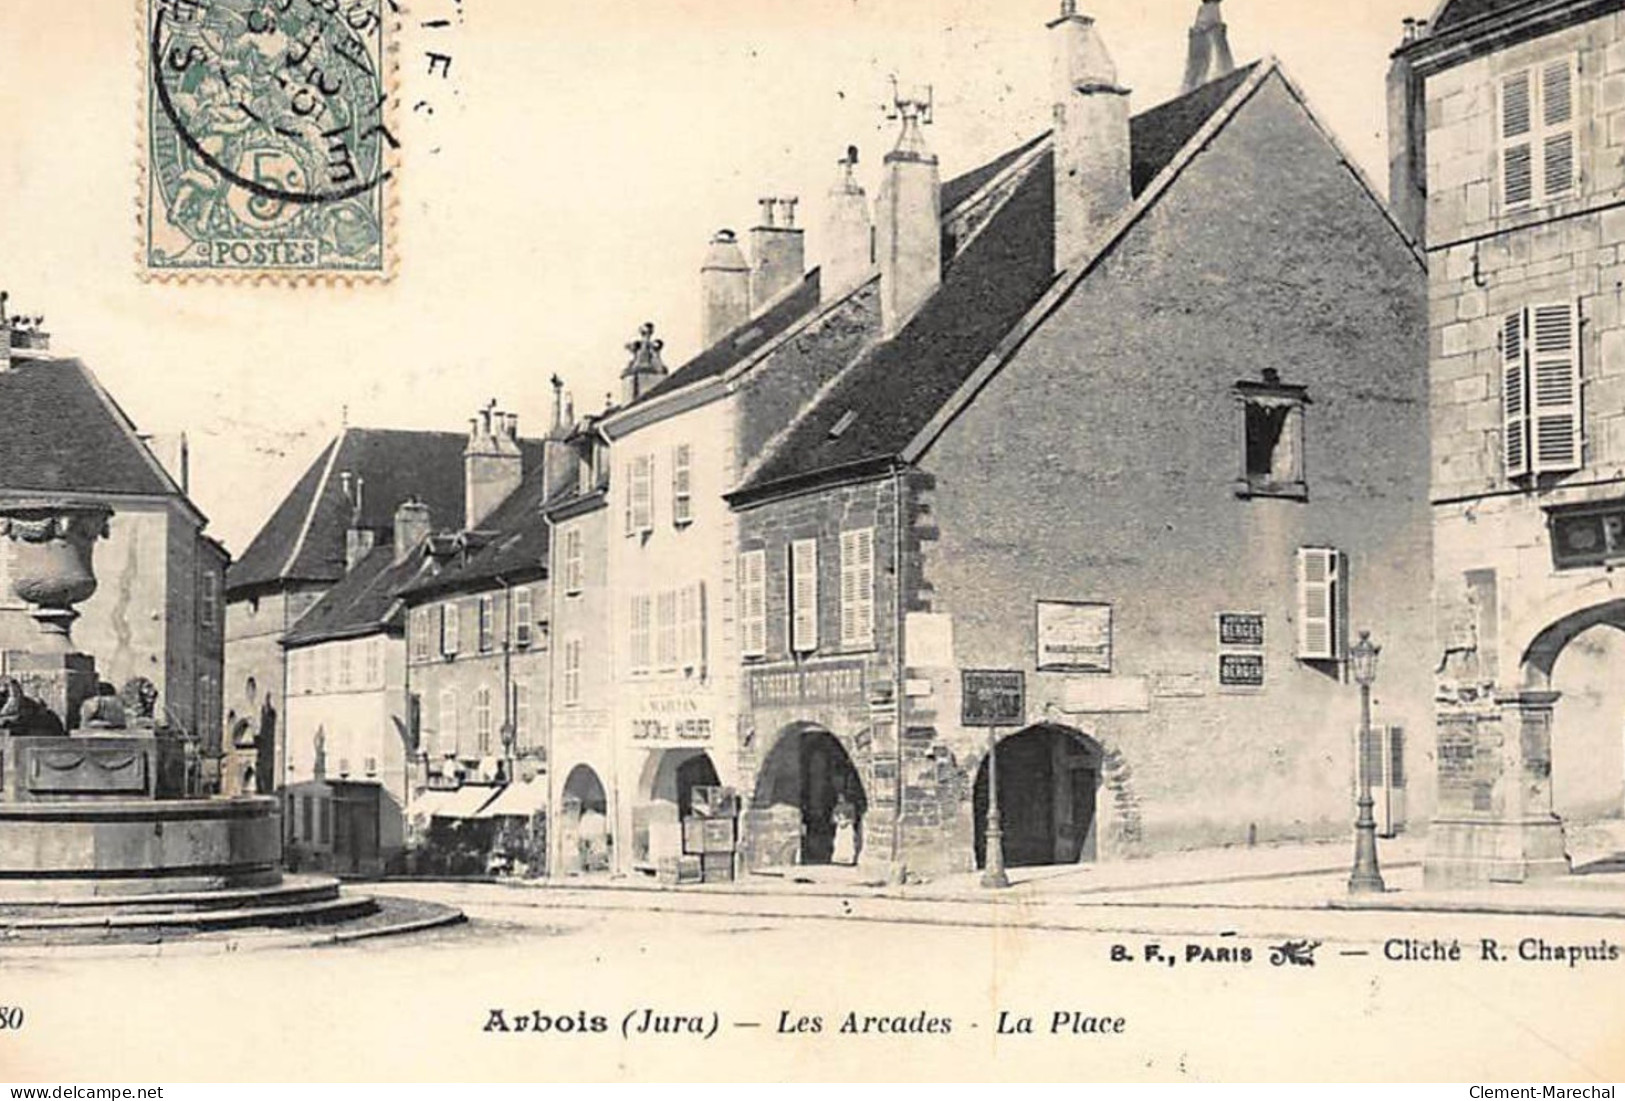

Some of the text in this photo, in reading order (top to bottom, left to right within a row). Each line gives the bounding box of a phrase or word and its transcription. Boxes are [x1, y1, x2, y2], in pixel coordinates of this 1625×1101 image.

[214, 240, 315, 265] POSTES
[1383, 938, 1461, 961] Cliché
[1481, 939, 1507, 962] R.
[1518, 938, 1620, 968] Chapuis
[483, 1009, 1126, 1039] Arbois (Jura) Les Arcades La Place
